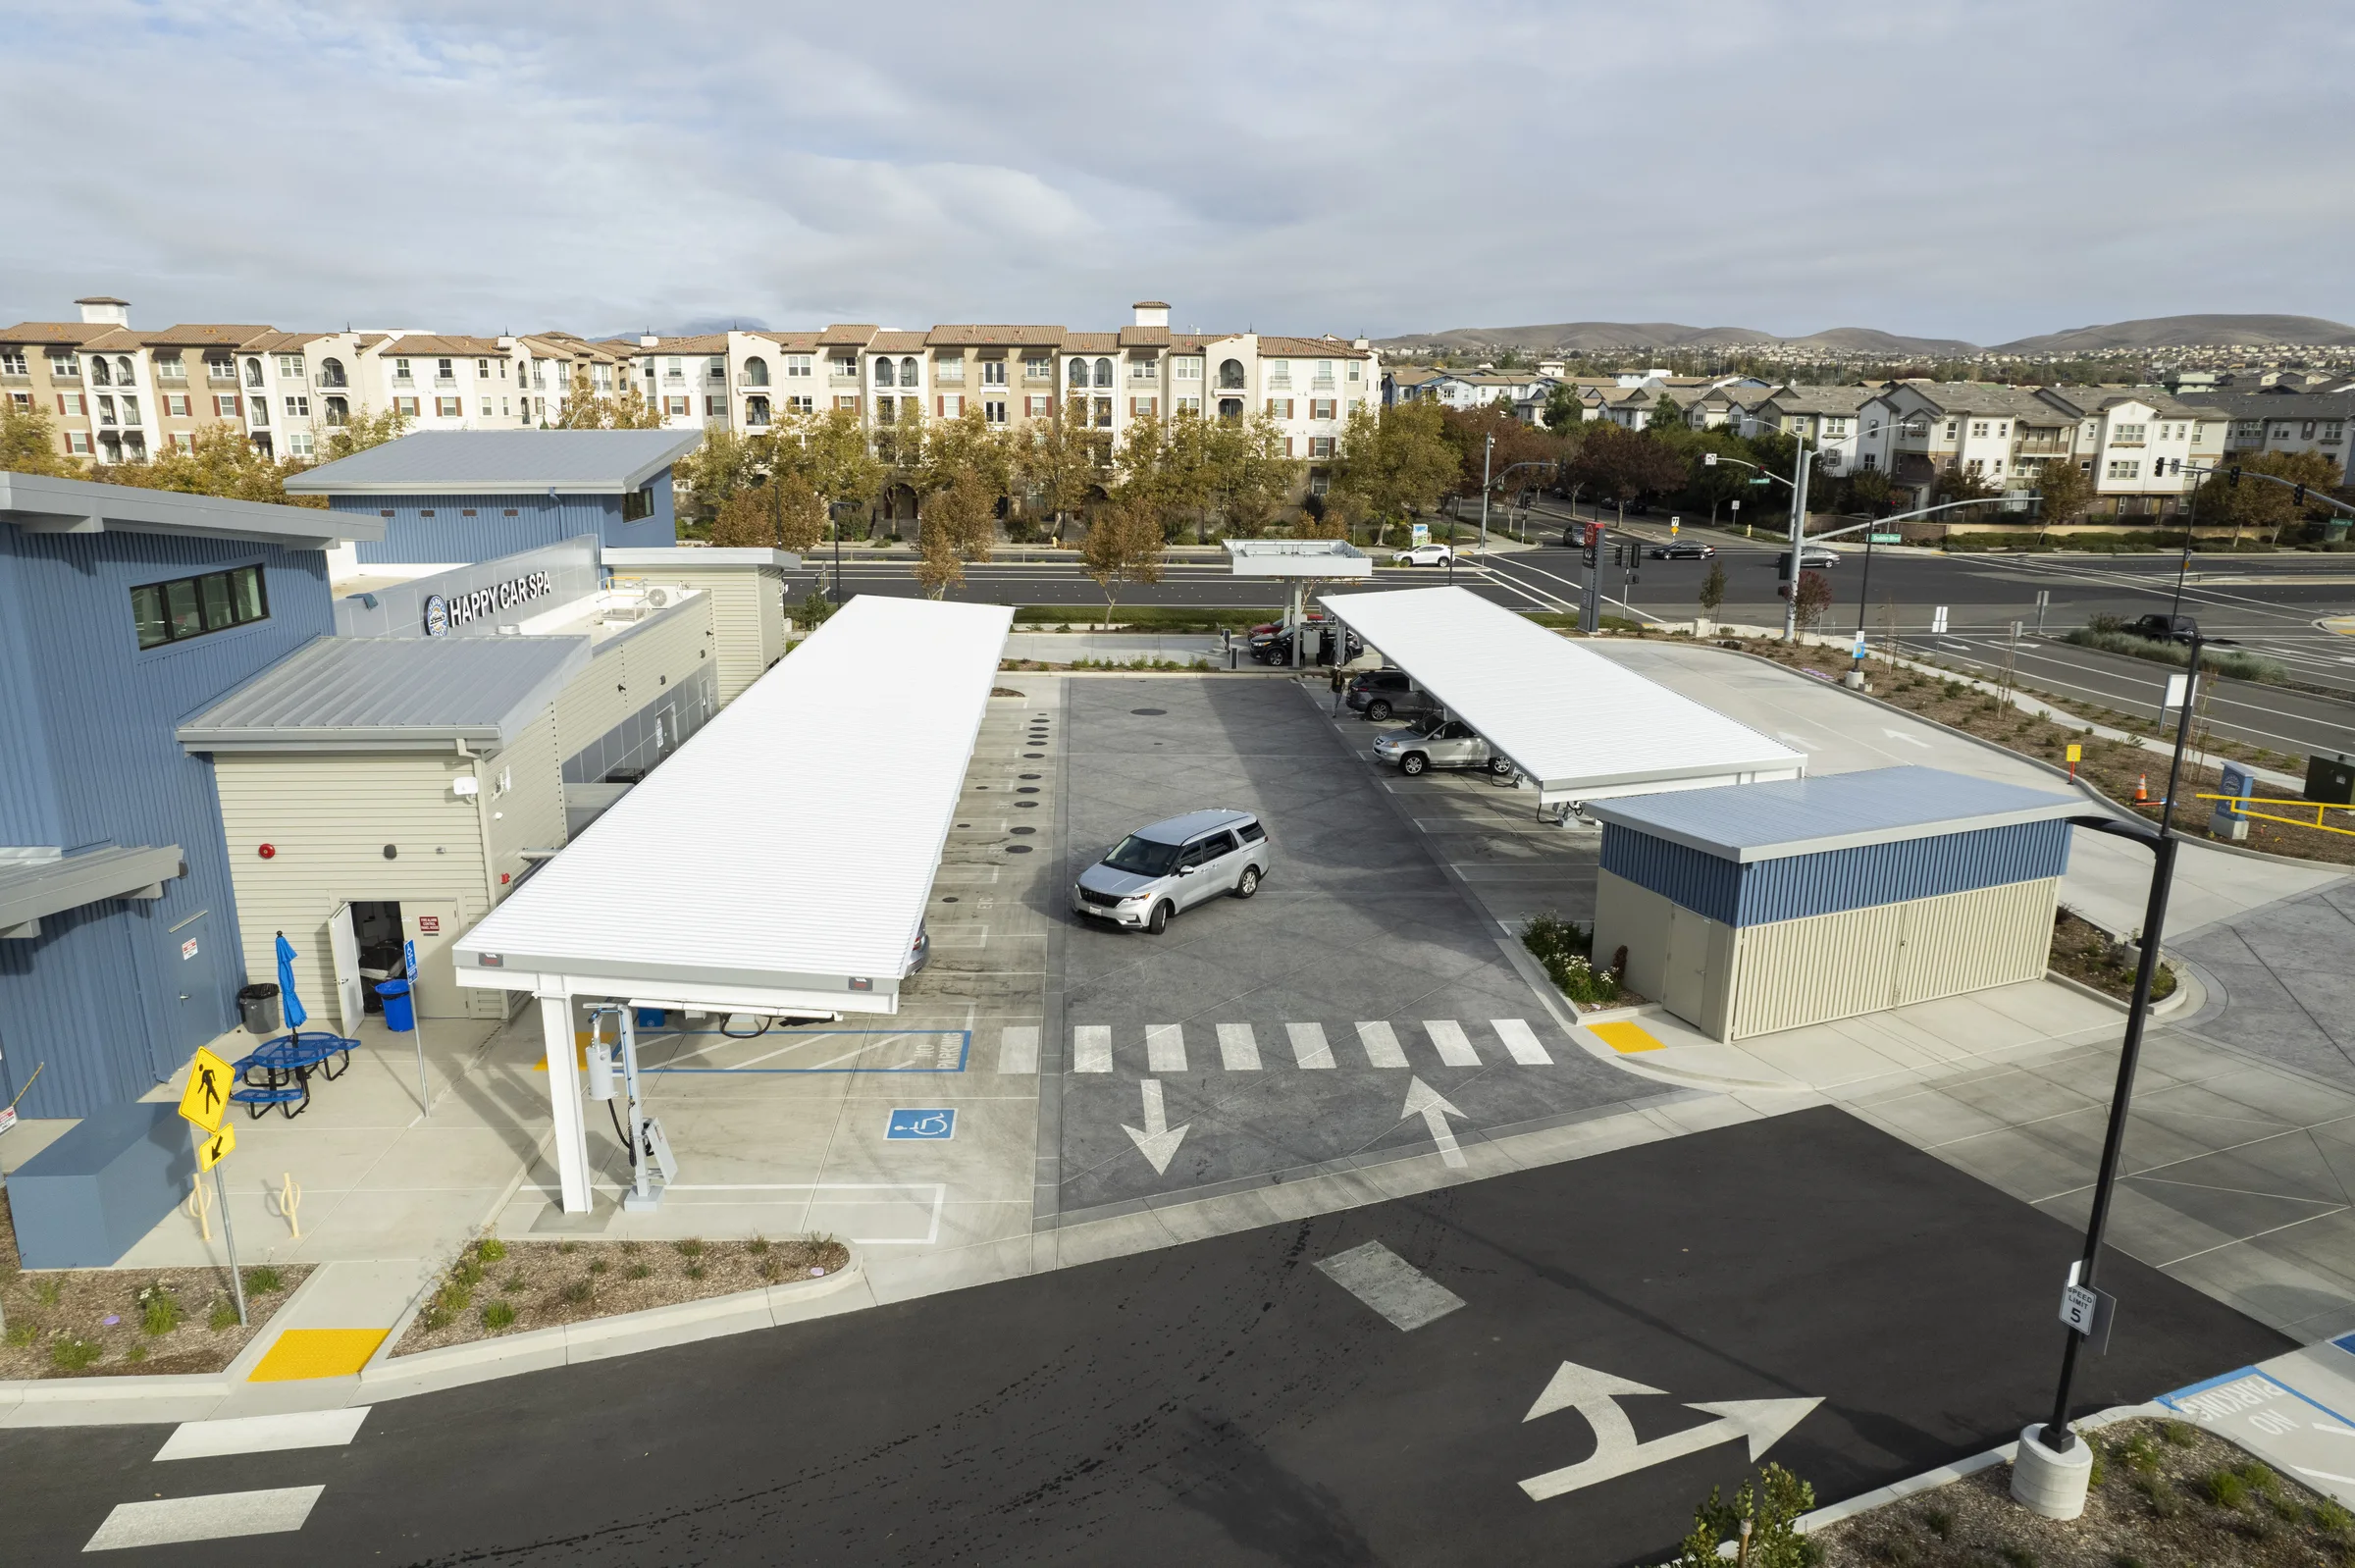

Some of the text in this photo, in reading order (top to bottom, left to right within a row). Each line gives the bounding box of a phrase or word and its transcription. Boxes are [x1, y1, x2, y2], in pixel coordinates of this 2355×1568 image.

[448, 570, 551, 628] HAPPY CAR SPA
[915, 1044, 935, 1057] NO
[937, 1033, 962, 1069] PARKING
[2067, 1286, 2093, 1304] SPEED
[2068, 1295, 2088, 1310] LIMIT
[2070, 1307, 2081, 1324] 5
[2179, 1375, 2286, 1423] PARKING
[2248, 1408, 2300, 1436] NO
